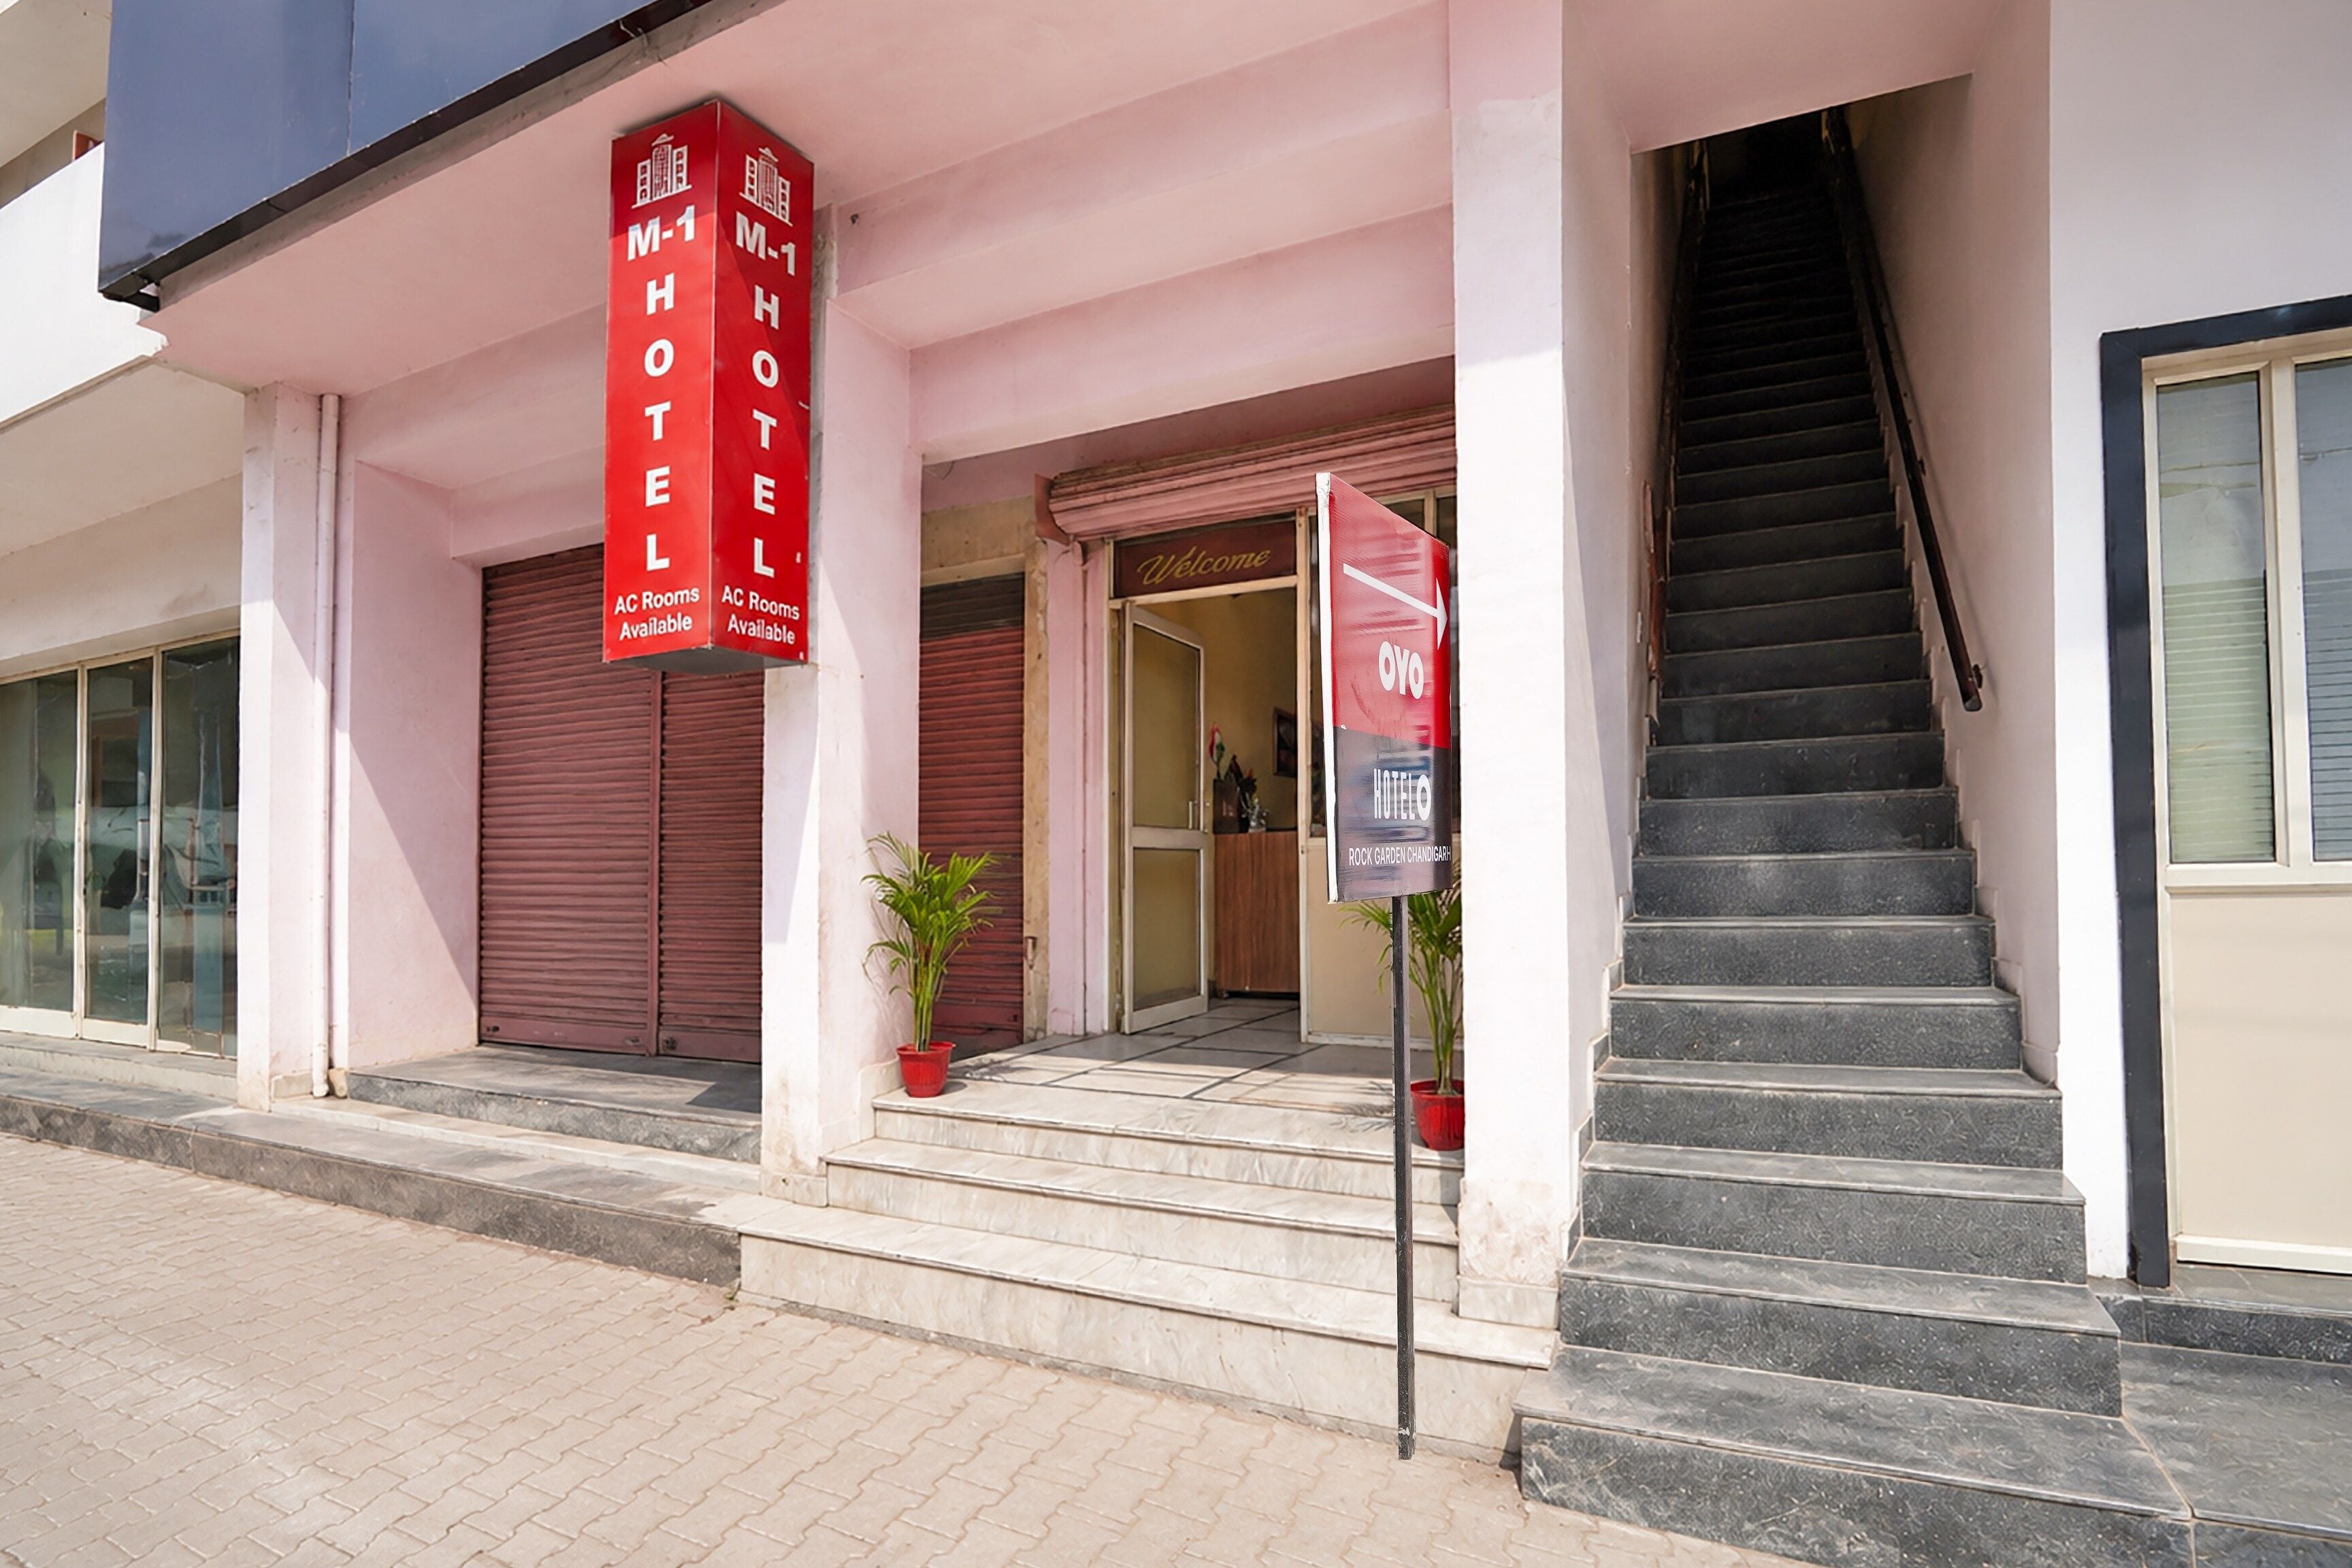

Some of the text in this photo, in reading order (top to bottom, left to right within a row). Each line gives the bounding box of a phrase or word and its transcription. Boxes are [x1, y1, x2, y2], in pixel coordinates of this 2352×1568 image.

[627, 205, 695, 261] M-1
[736, 212, 796, 276] M-1
[644, 272, 674, 571] HOTEL
[752, 284, 779, 578] HOTEL
[1137, 546, 1271, 585] Welcome
[614, 587, 700, 615] AC Rooms
[721, 585, 800, 620] AC Rooms
[619, 612, 693, 640] Available
[728, 614, 795, 644] Available
[1378, 640, 1424, 700] OYO
[1349, 845, 1451, 866] ROCK GARDEN CHANDIGARH
